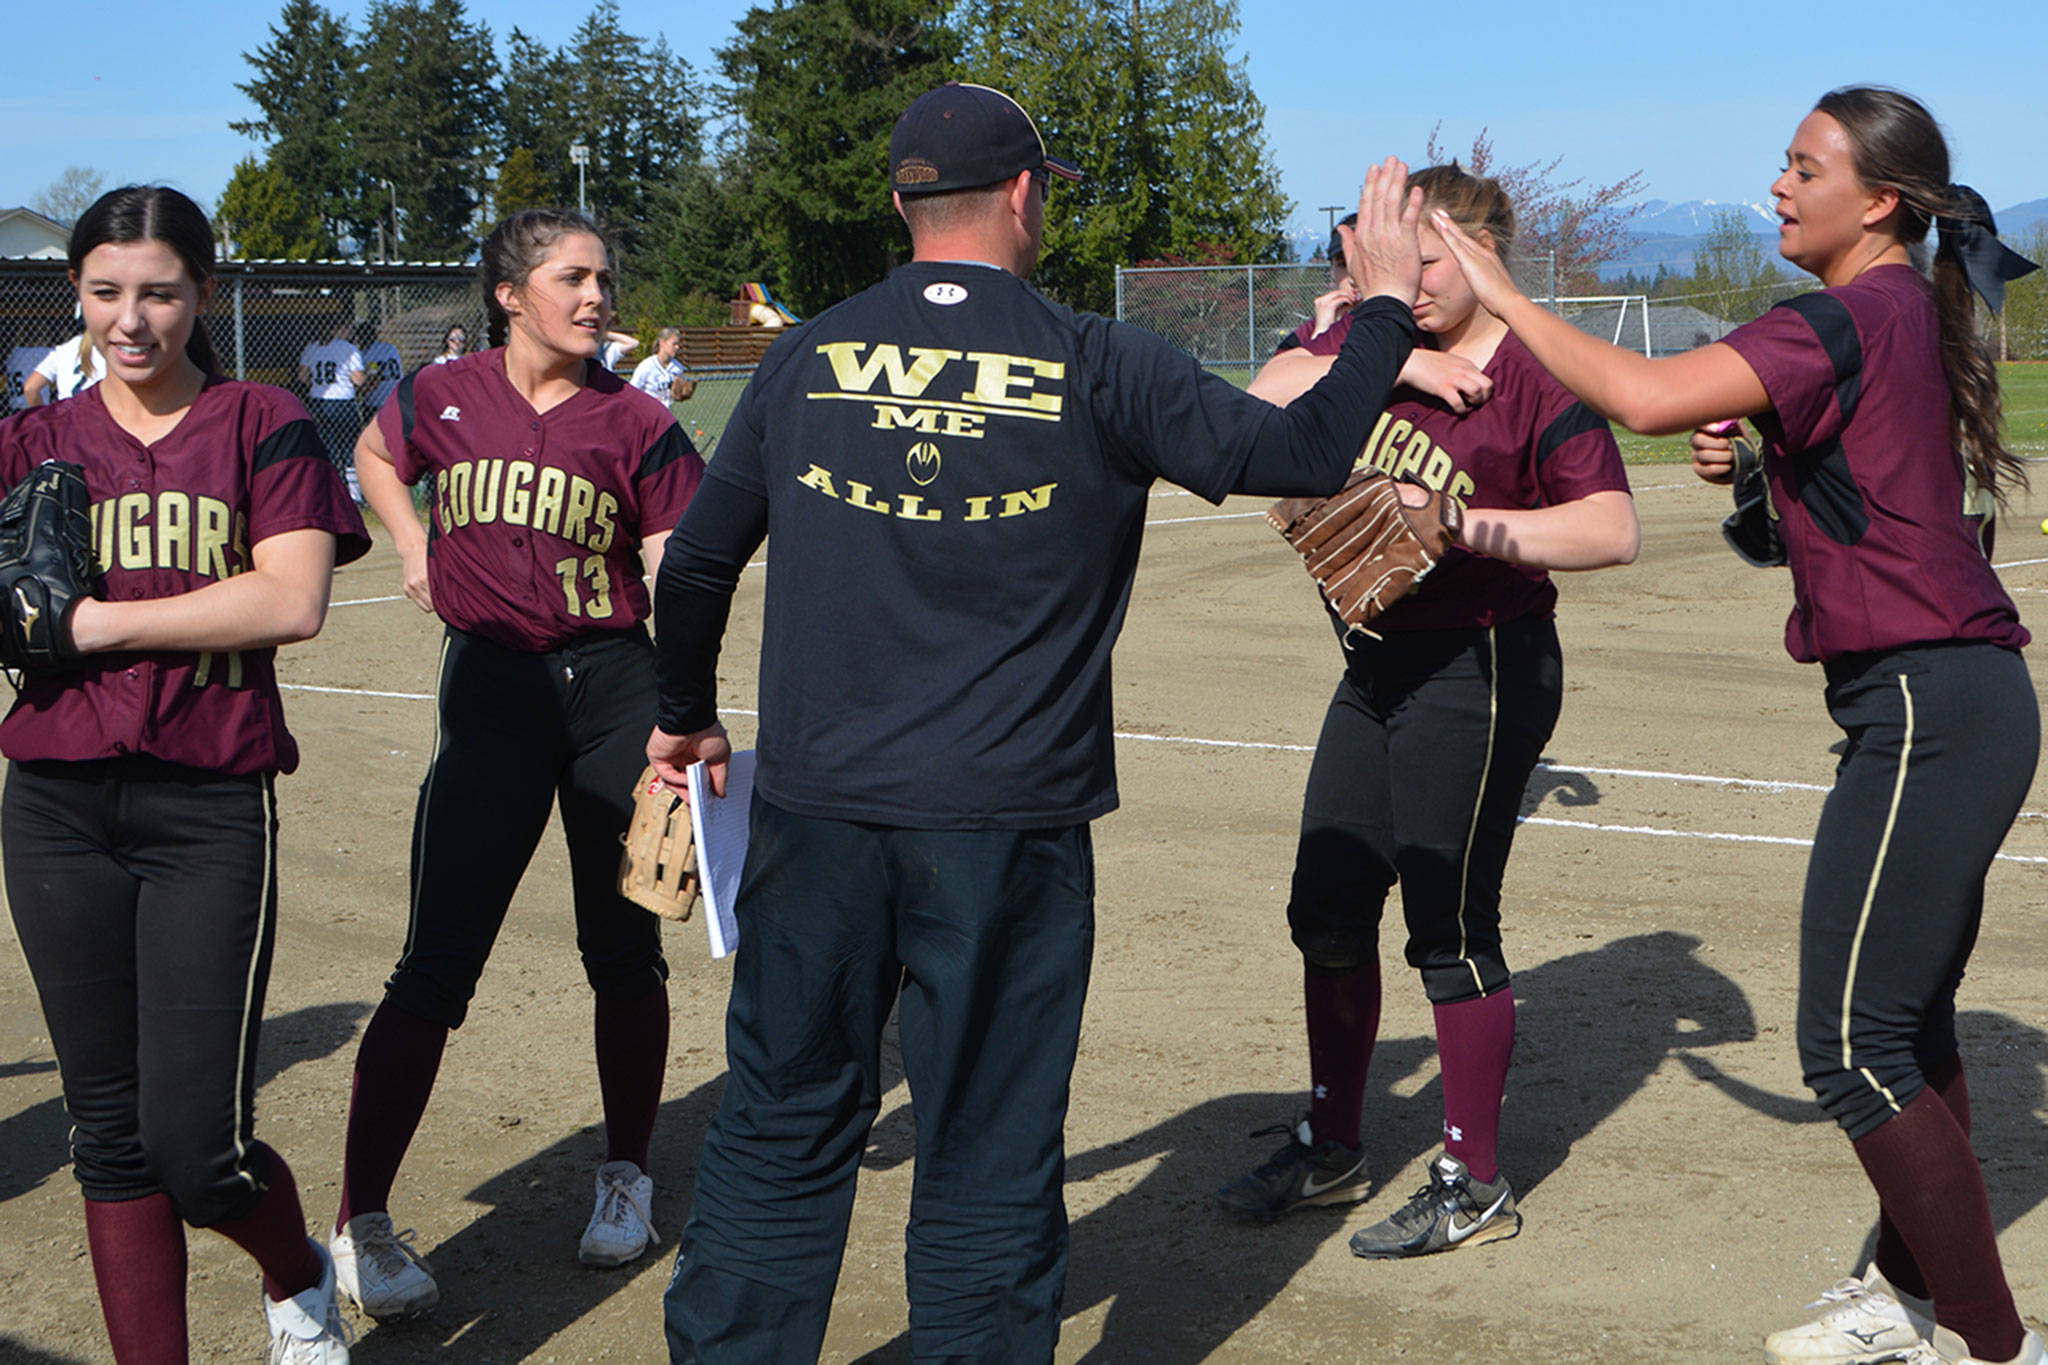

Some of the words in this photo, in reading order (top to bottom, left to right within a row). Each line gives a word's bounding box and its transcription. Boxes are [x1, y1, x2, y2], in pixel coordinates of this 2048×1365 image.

[314, 361, 337, 385] 18
[815, 341, 1065, 412] WE
[871, 404, 986, 438] ME
[437, 458, 619, 554] COUGARS
[796, 463, 944, 522] ALL
[963, 482, 1059, 522] IN
[555, 554, 614, 619] 13
